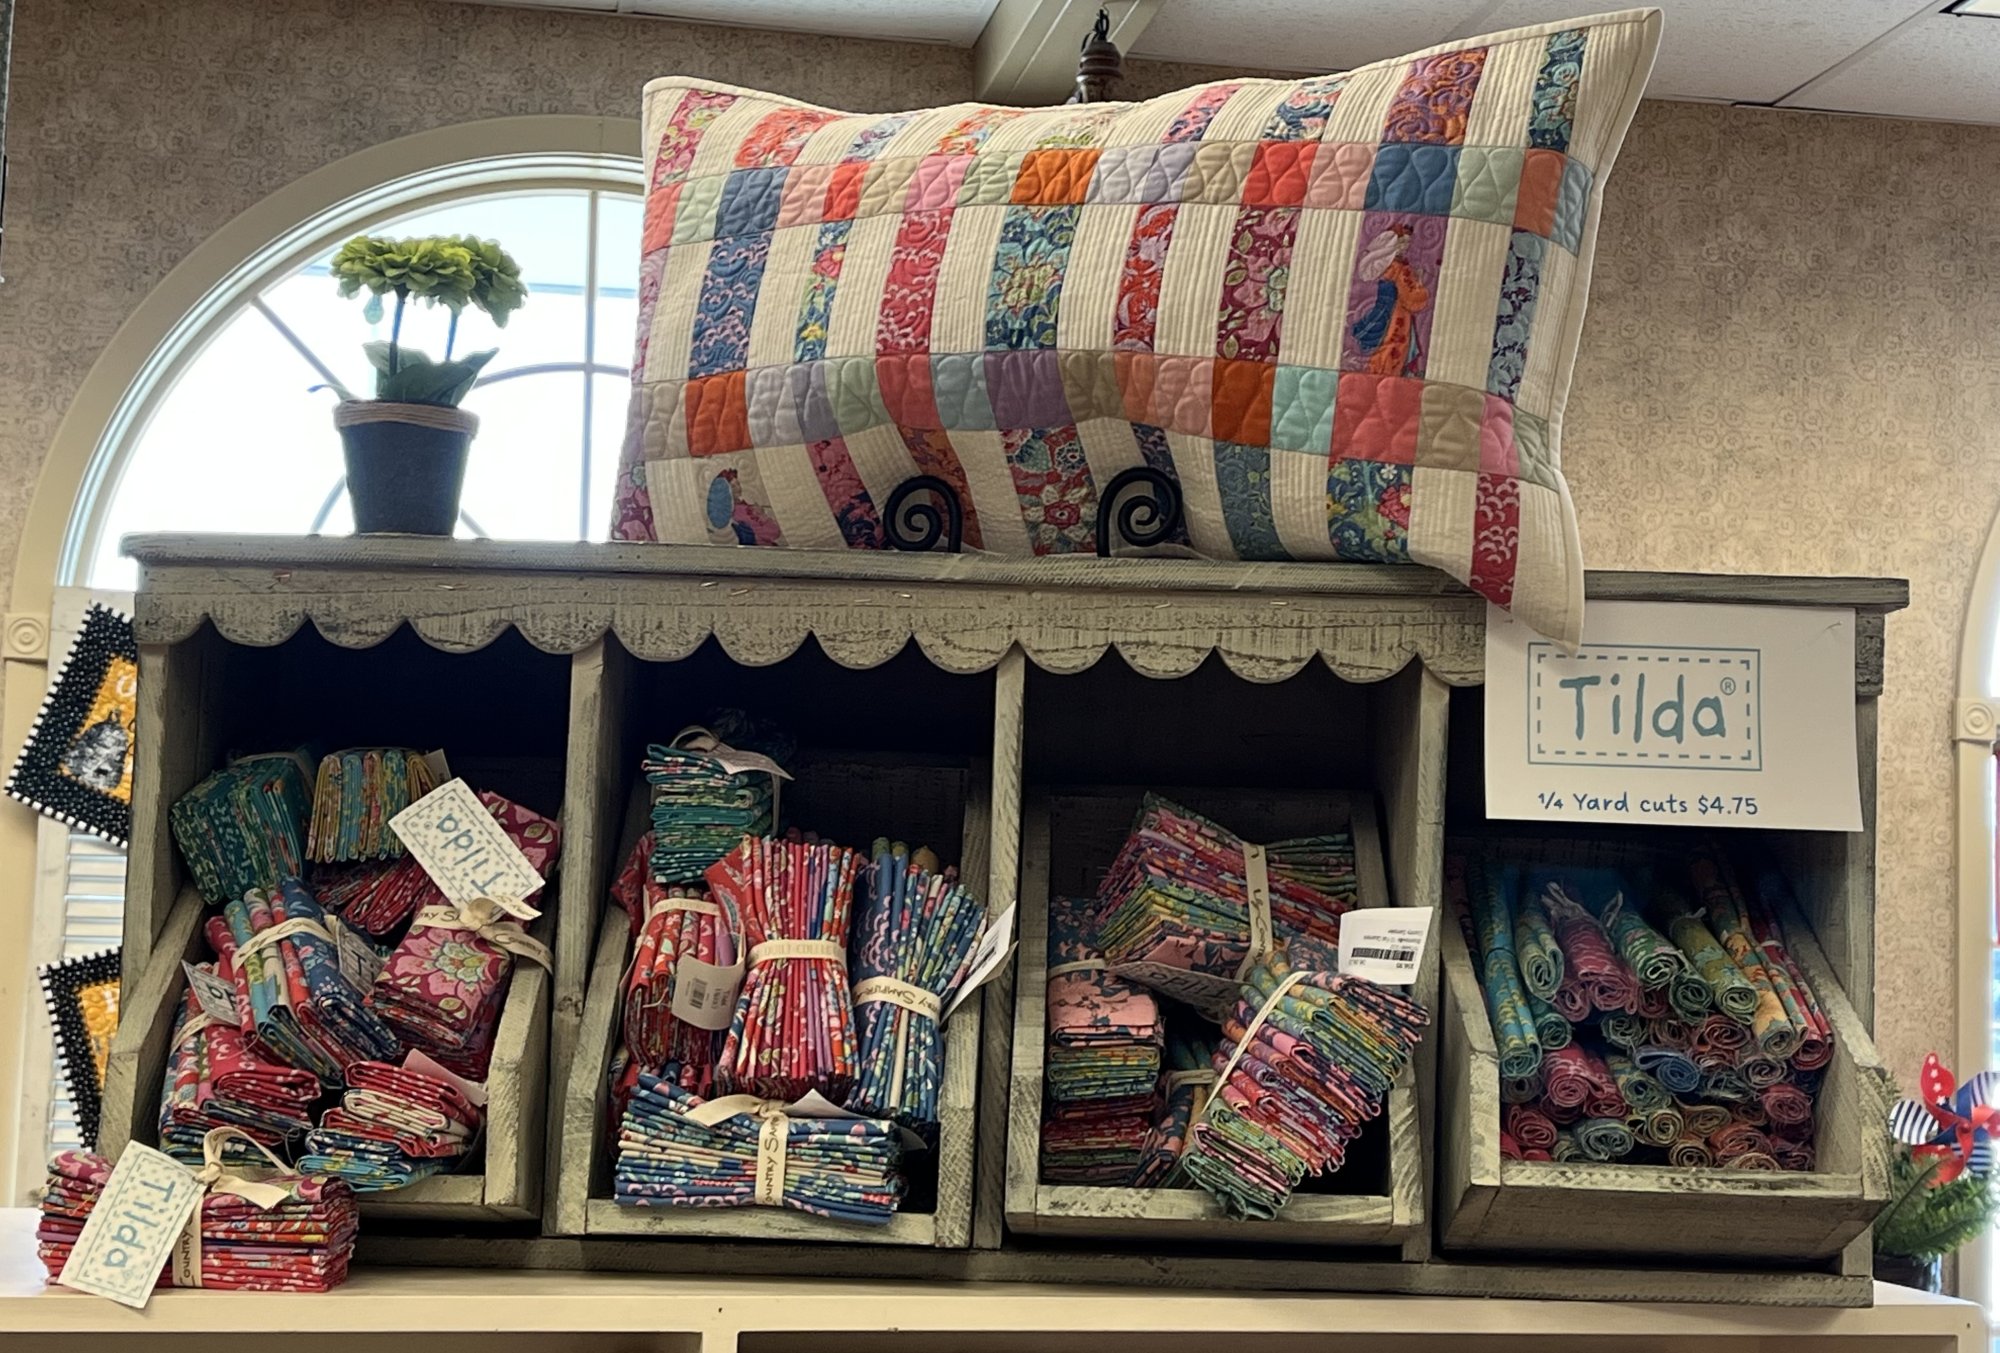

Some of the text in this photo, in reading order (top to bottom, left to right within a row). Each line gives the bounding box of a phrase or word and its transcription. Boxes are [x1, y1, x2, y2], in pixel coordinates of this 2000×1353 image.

[1573, 791, 1629, 813] Yard
[1639, 796, 1688, 814] cuts
[1698, 795, 1758, 816] $4.75
[104, 1180, 176, 1268] Tilda
